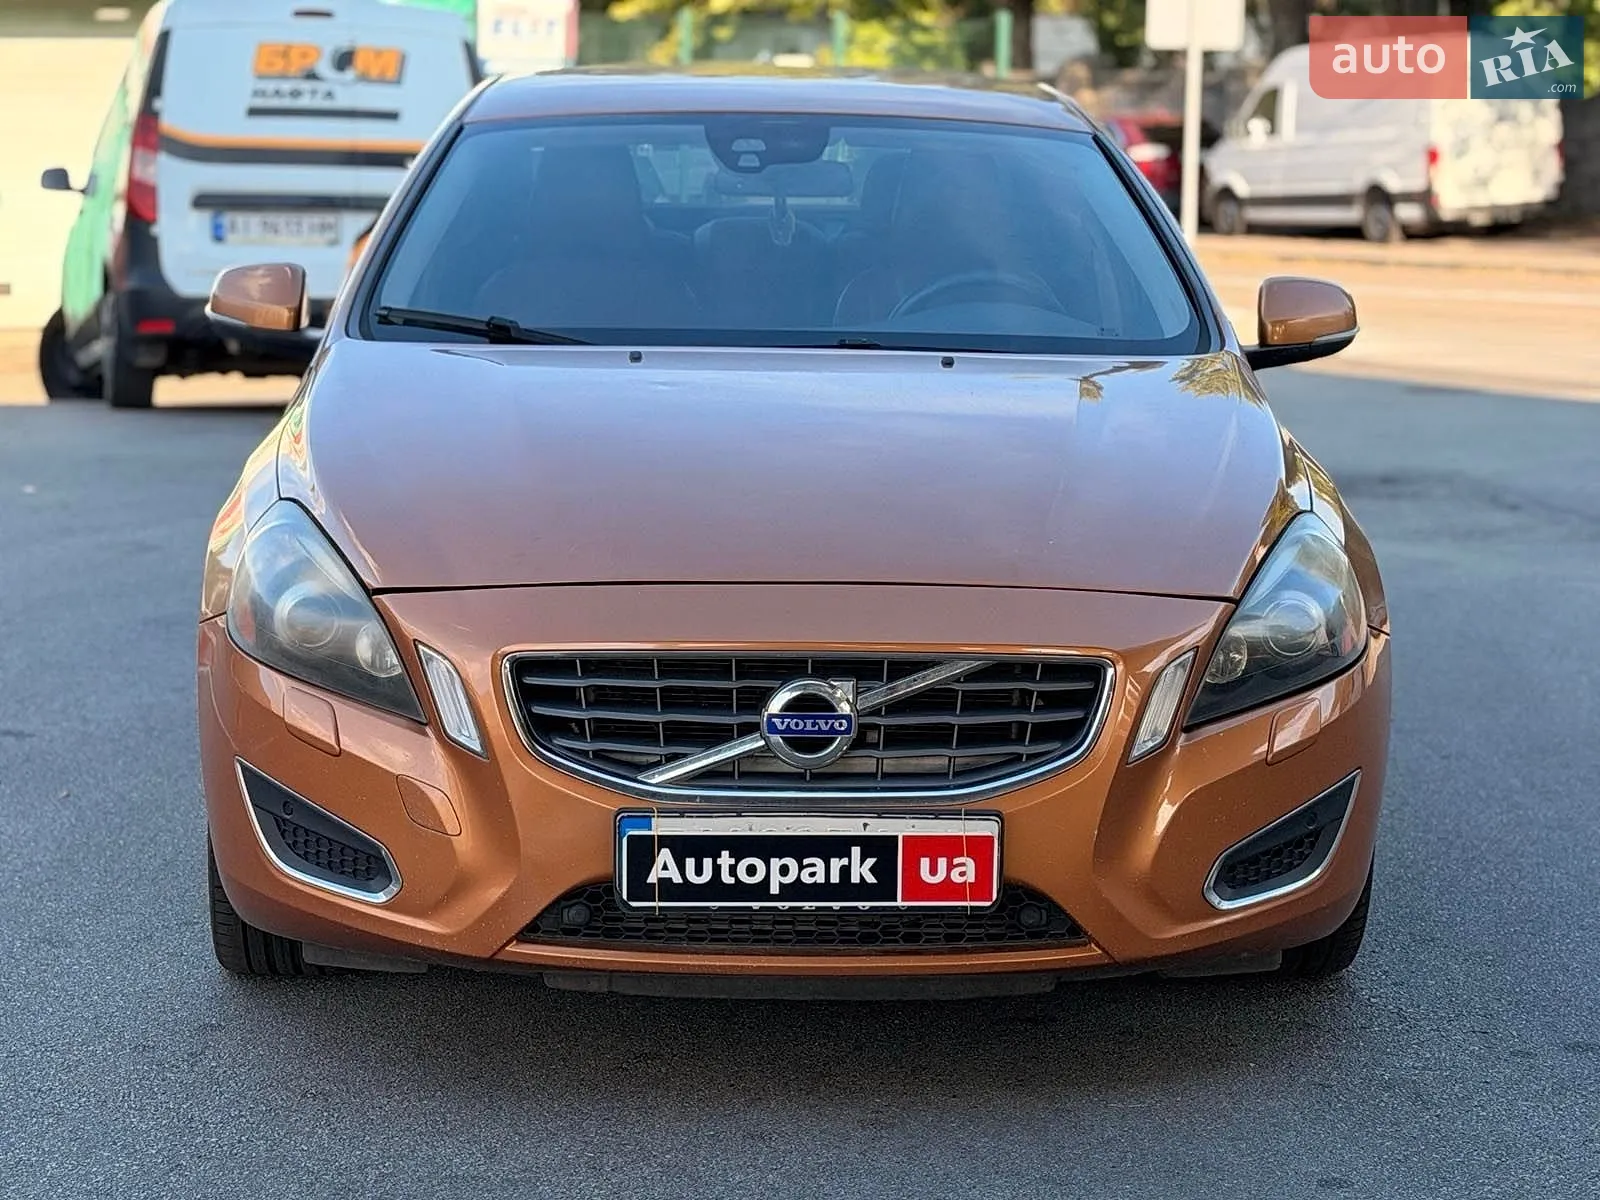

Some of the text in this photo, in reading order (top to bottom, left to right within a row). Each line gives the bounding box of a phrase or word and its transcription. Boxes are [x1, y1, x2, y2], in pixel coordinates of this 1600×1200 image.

[771, 718, 848, 731] VOLVO
[646, 846, 976, 895] Autopark ua
